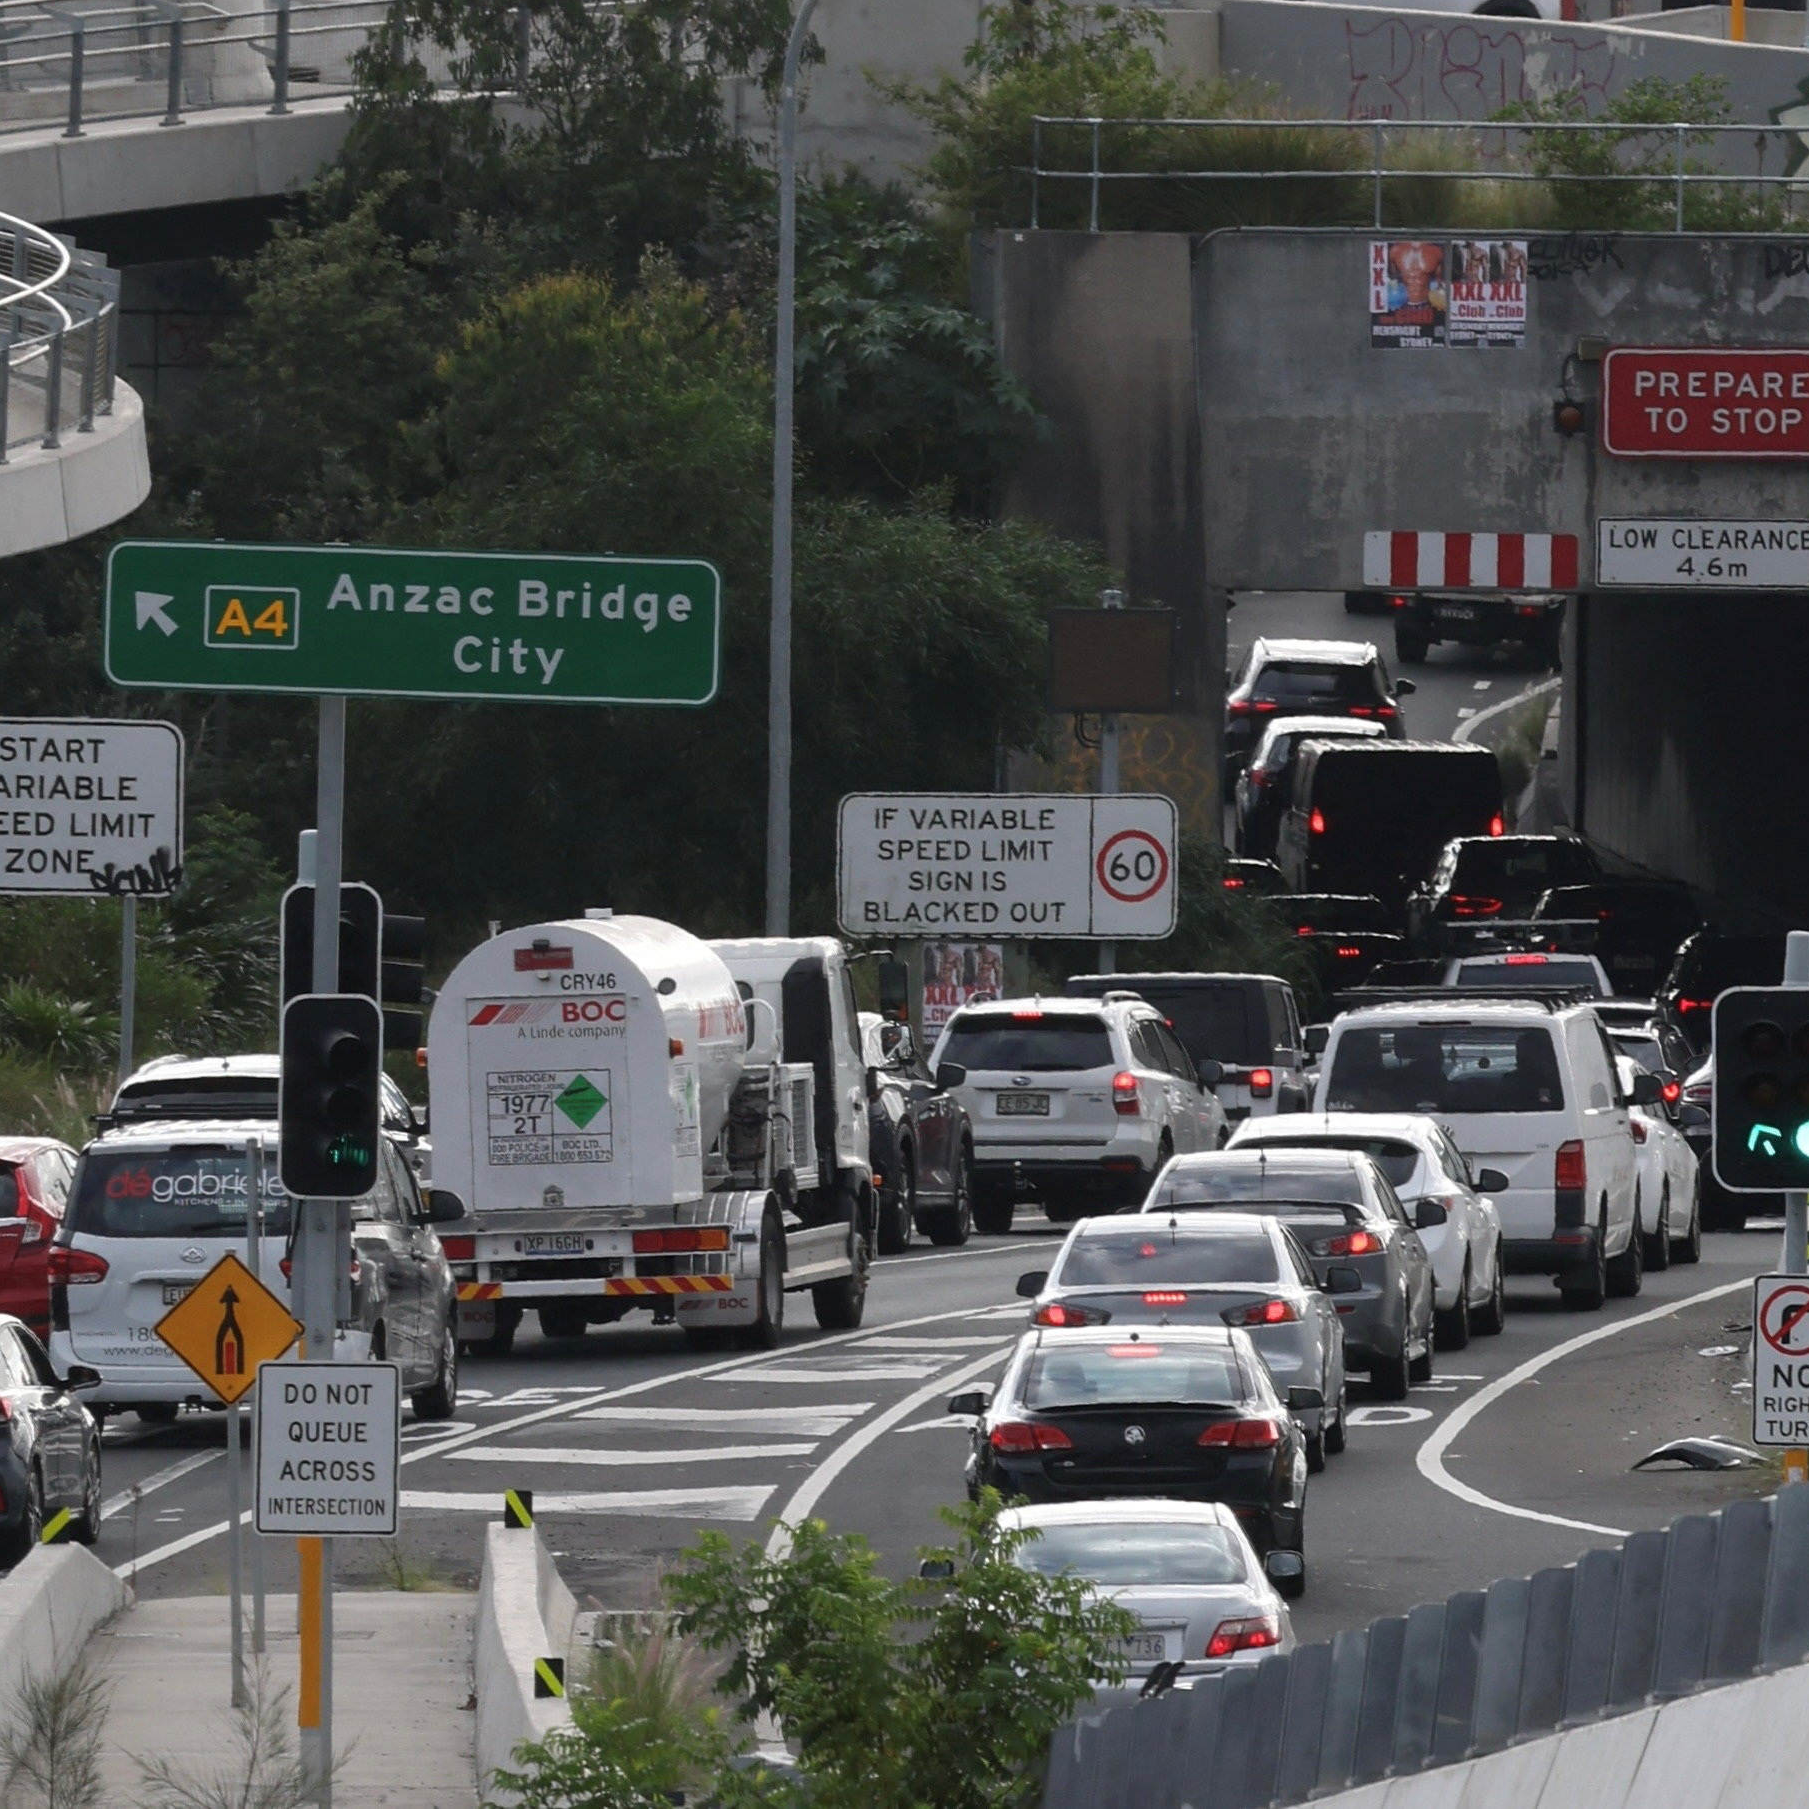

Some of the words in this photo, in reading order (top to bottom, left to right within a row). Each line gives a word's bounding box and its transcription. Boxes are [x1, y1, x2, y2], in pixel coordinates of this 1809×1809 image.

[1451, 281, 1487, 302] XXL
[1489, 281, 1524, 302] XXL
[1458, 304, 1486, 318] Club
[1496, 304, 1524, 318] Club
[1644, 406, 1688, 434] TO
[1711, 408, 1803, 434] STOP
[1609, 529, 1658, 549] LOW
[1676, 556, 1748, 578] 4.6m
[326, 573, 495, 618] Anzac
[518, 580, 693, 634] Bridge
[215, 599, 288, 638] A4
[452, 636, 565, 685] City
[70, 812, 156, 839] LIMIT
[874, 808, 899, 830] IF
[909, 808, 1056, 831] VARIABLE
[877, 840, 972, 861] SPEED
[981, 840, 1054, 861] LIMIT
[4, 848, 95, 875] ZONE
[1109, 849, 1157, 883] 60
[907, 870, 973, 892] SIGN
[981, 870, 1008, 892] IS
[863, 901, 999, 923] BLACKED
[1010, 901, 1067, 923] OUT
[560, 973, 616, 991] CRY46
[561, 999, 625, 1023] BOC
[517, 1027, 526, 1040] A
[530, 1024, 565, 1039] Linde
[569, 1024, 625, 1041] company
[498, 1074, 556, 1084] NITROGEN
[501, 1094, 550, 1114] 1977
[514, 1116, 542, 1135] 2T
[508, 1142, 540, 1153] POLICE
[562, 1140, 581, 1149] BOC
[492, 1153, 511, 1162] FIRE
[512, 1152, 551, 1162] BRIGADE
[174, 1198, 224, 1206] KITCHENS
[527, 1235, 543, 1250] XP
[717, 1296, 750, 1311] BOC
[463, 1310, 492, 1323] BOC
[285, 1384, 316, 1404] DO
[327, 1384, 372, 1404] NOT
[288, 1422, 367, 1443] QUEUE
[280, 1461, 375, 1481] ACROSS
[266, 1498, 385, 1515] INTERSECTION
[1135, 1638, 1163, 1654] 736
